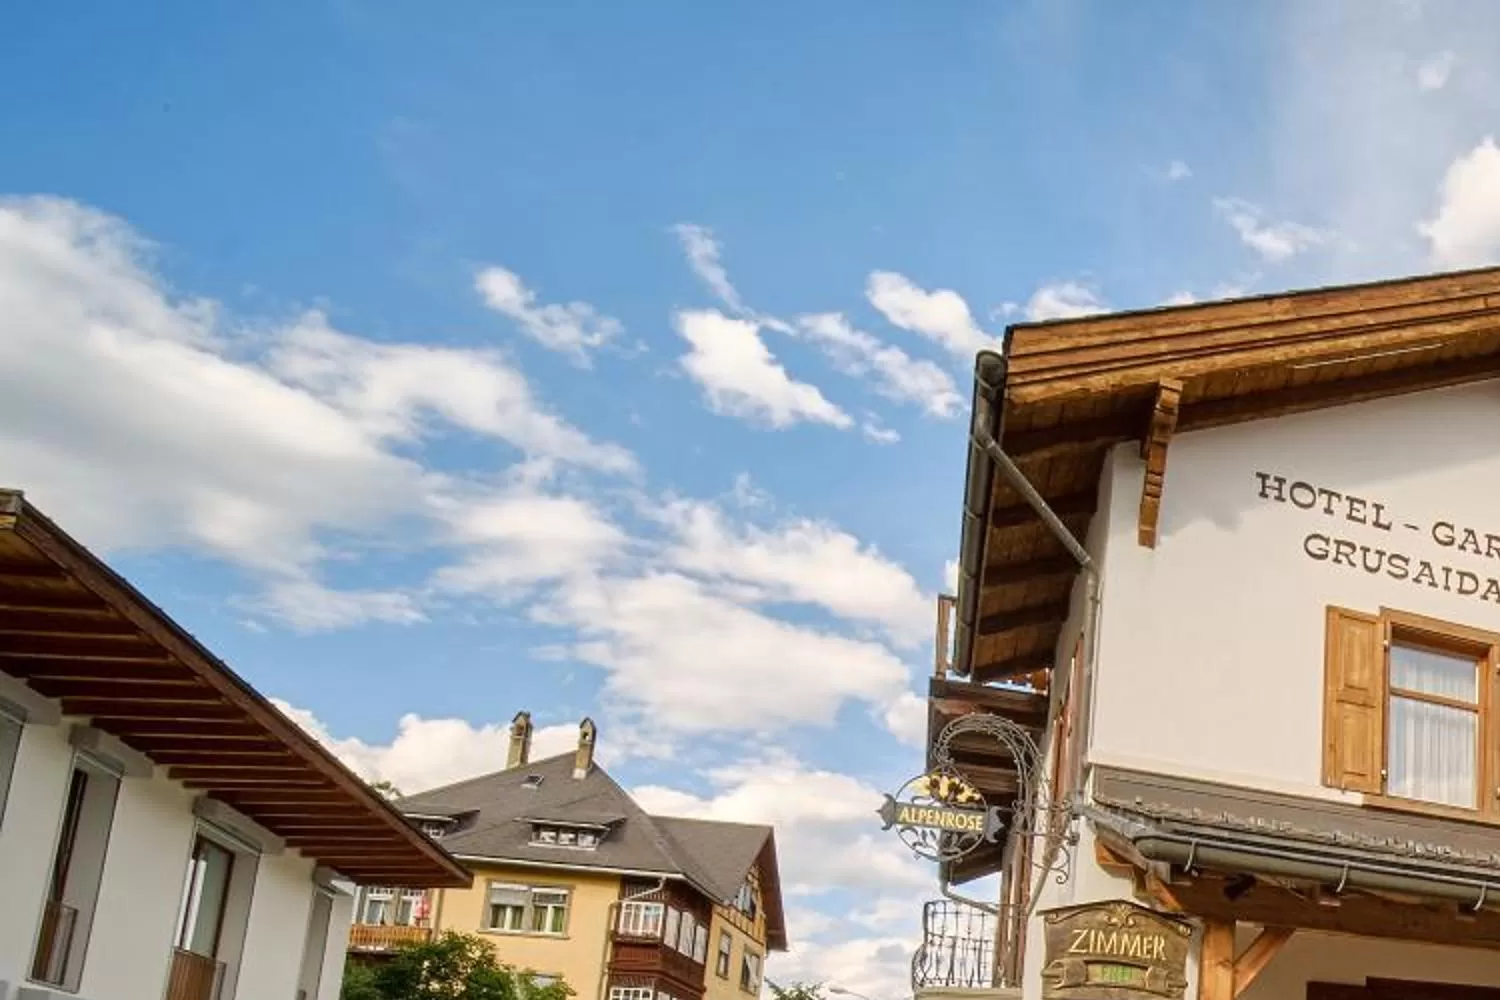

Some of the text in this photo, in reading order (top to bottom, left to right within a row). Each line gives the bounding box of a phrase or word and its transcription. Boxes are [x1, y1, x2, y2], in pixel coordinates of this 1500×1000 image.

[1255, 471, 1392, 532] HOTEL
[900, 806, 984, 831] ALPENROSE
[1068, 929, 1168, 961] ZIMMER
